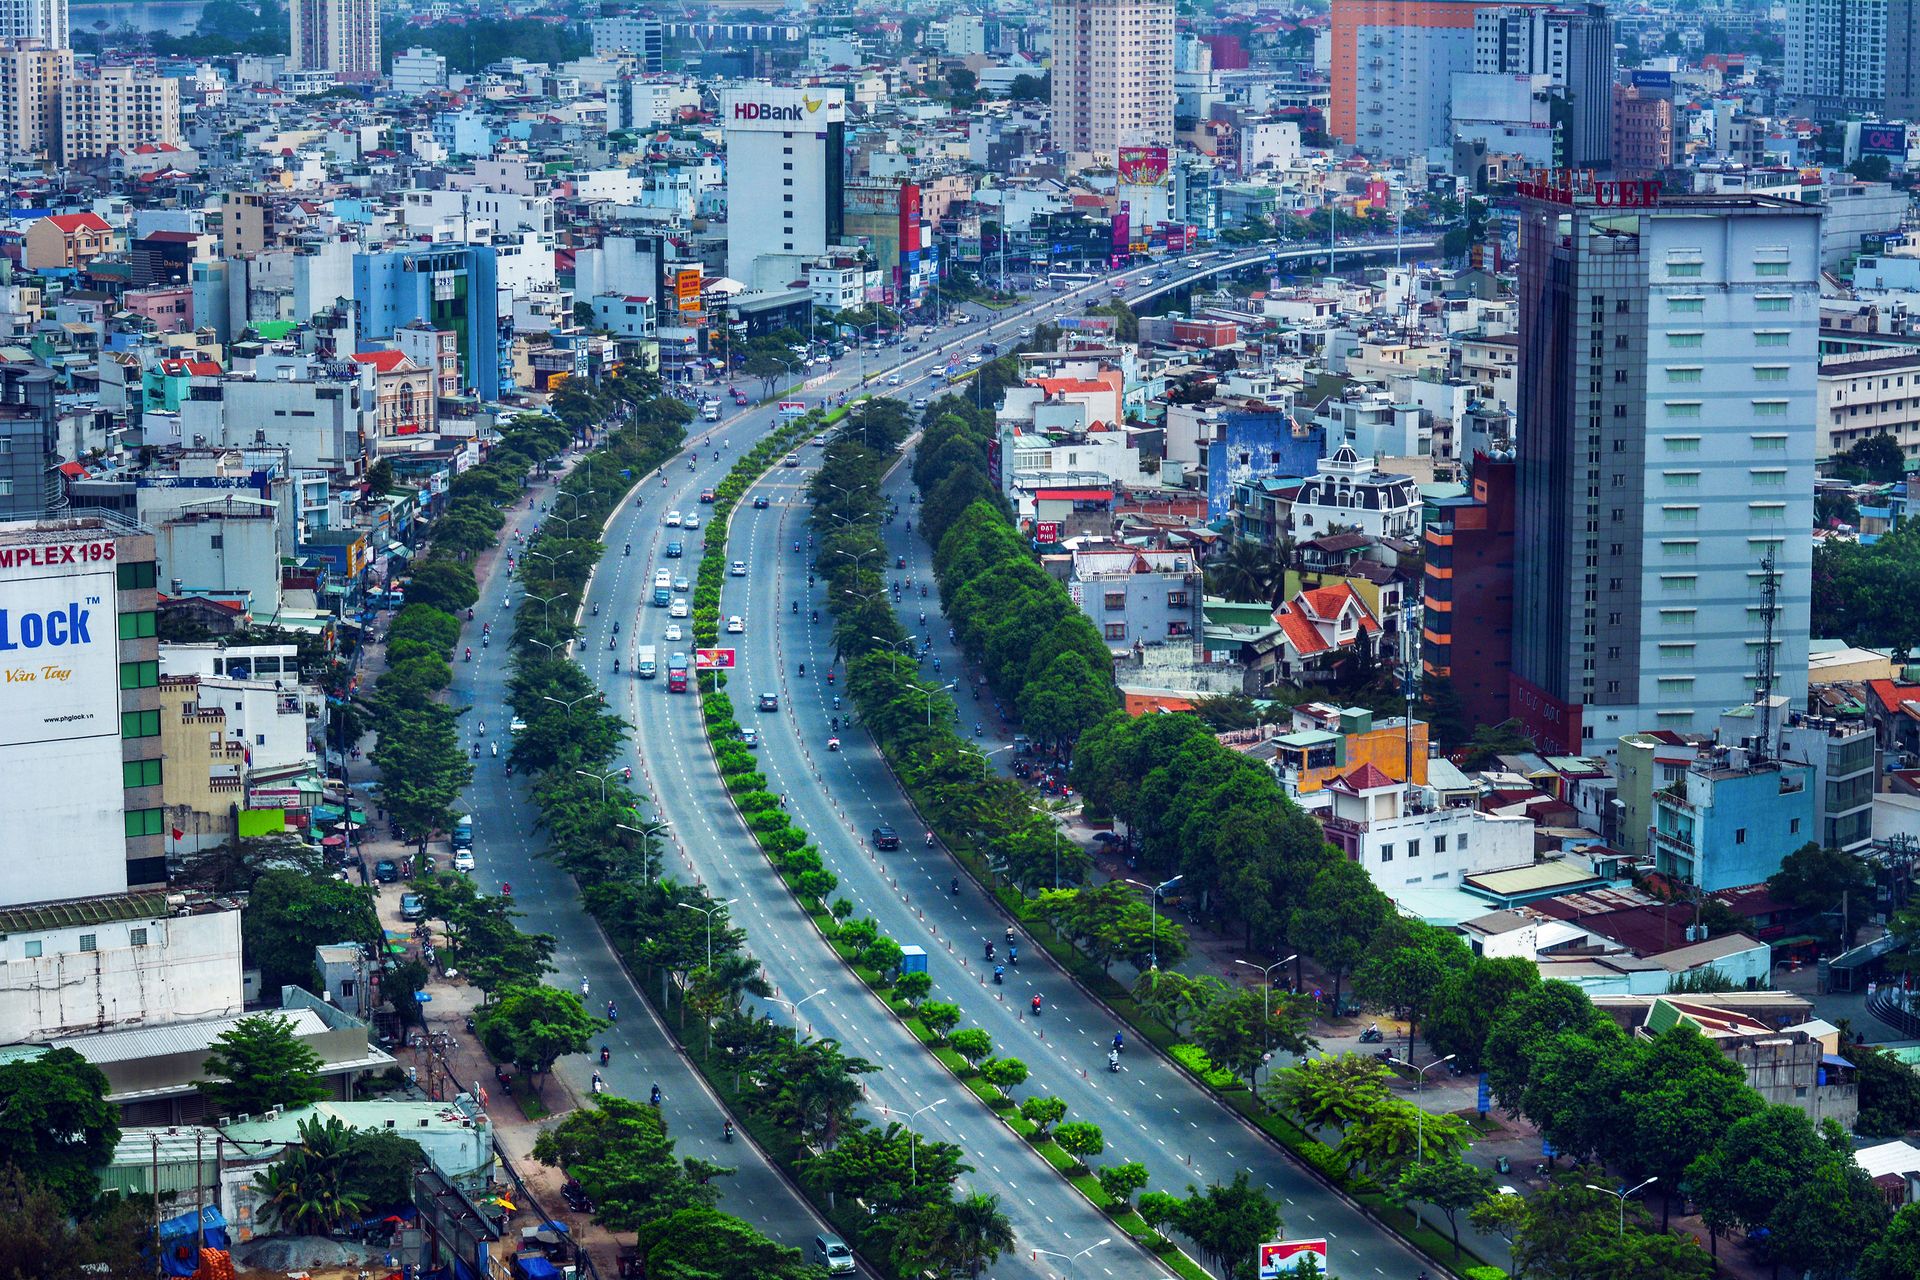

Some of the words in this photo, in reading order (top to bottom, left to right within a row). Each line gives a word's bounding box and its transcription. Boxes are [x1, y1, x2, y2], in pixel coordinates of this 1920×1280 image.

[735, 103, 803, 121] HDBank
[1870, 132, 1895, 148] CAE
[1595, 181, 1663, 208] UEF
[0, 544, 76, 569] MPLEX
[79, 542, 116, 563] 195
[41, 665, 72, 683] Tay
